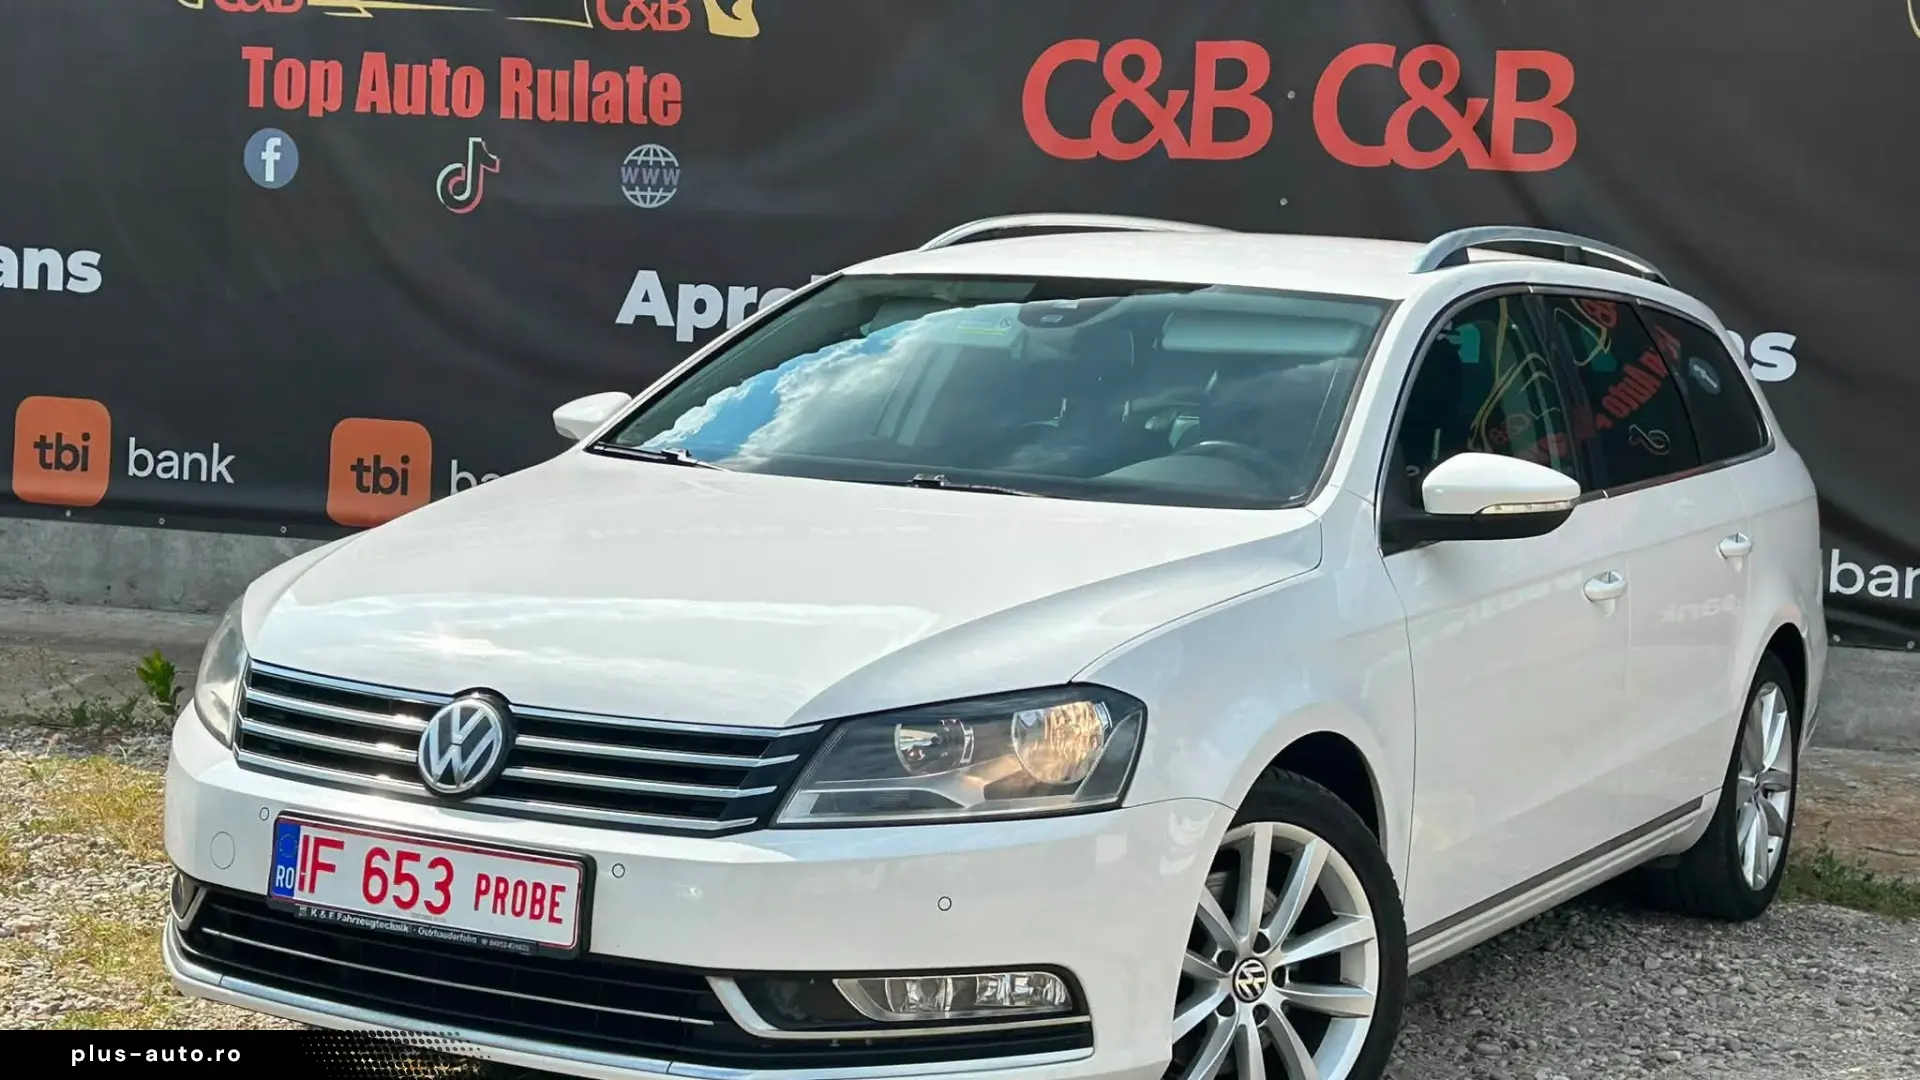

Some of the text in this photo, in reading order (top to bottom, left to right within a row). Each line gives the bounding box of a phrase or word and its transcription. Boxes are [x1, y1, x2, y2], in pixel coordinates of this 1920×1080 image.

[242, 46, 682, 126] Top Auto Rulate
[1022, 38, 1577, 172] C&B C&B
[615, 269, 826, 343] Apr
[33, 432, 236, 484] tbi bank
[350, 454, 410, 495] tbi
[275, 864, 295, 889] RO
[362, 847, 454, 915] 653
[474, 873, 566, 924] PROBE
